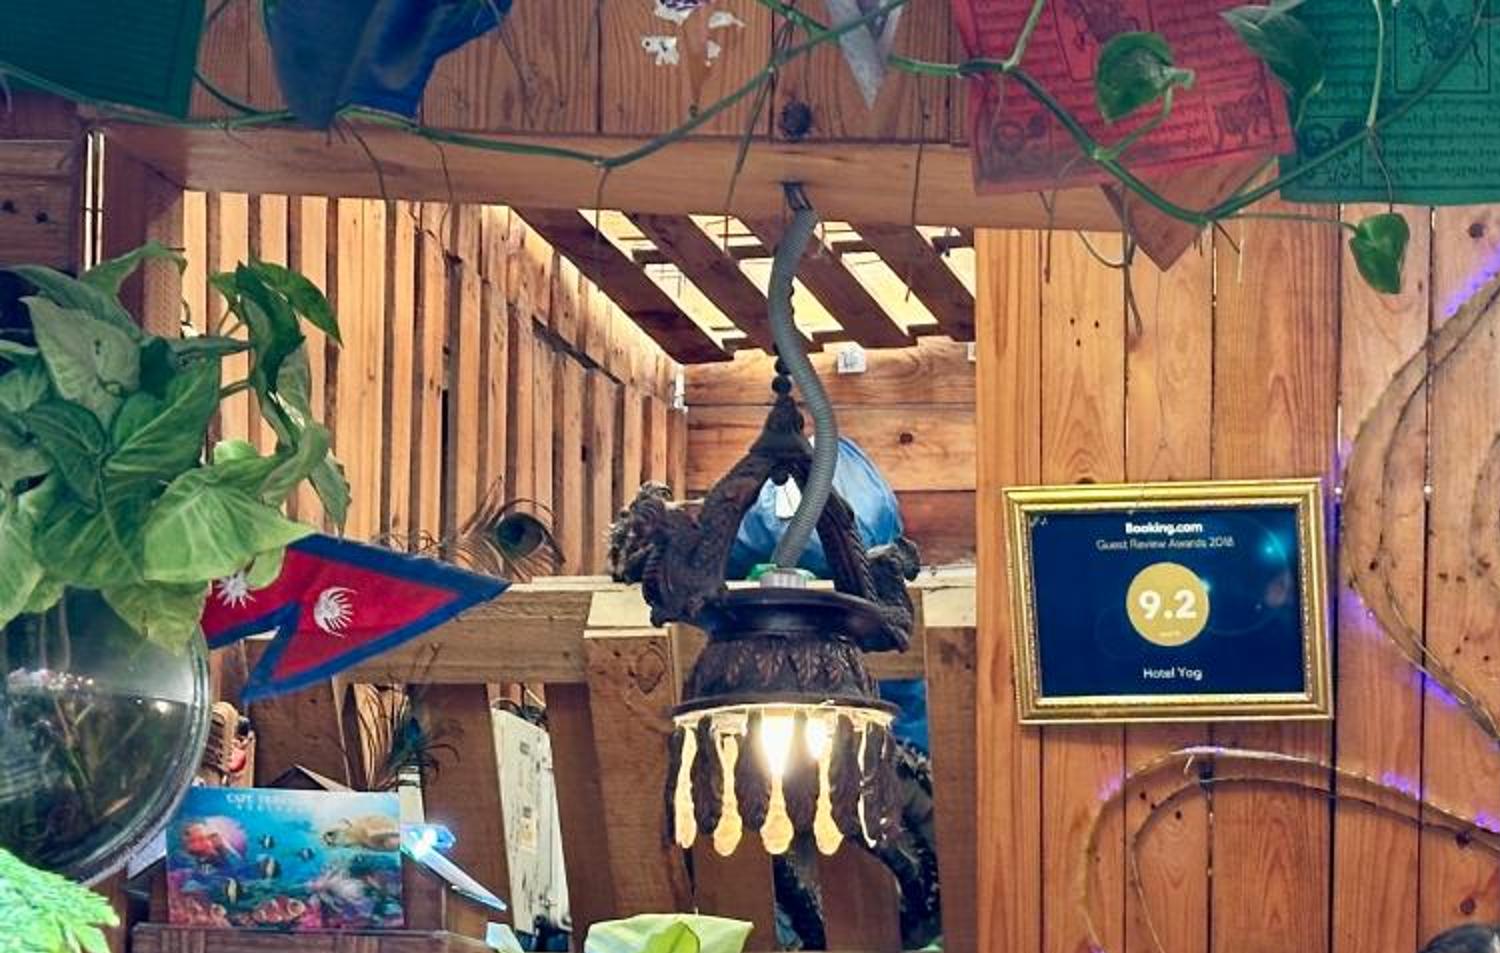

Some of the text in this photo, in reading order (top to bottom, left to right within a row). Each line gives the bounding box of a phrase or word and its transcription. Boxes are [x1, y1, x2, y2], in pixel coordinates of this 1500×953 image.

[1125, 521, 1203, 537] Booking.com
[1096, 539, 1129, 552] Guest
[1130, 538, 1166, 550] Review
[1139, 589, 1198, 620] 9.2
[1143, 665, 1203, 681] Hotel Yog
